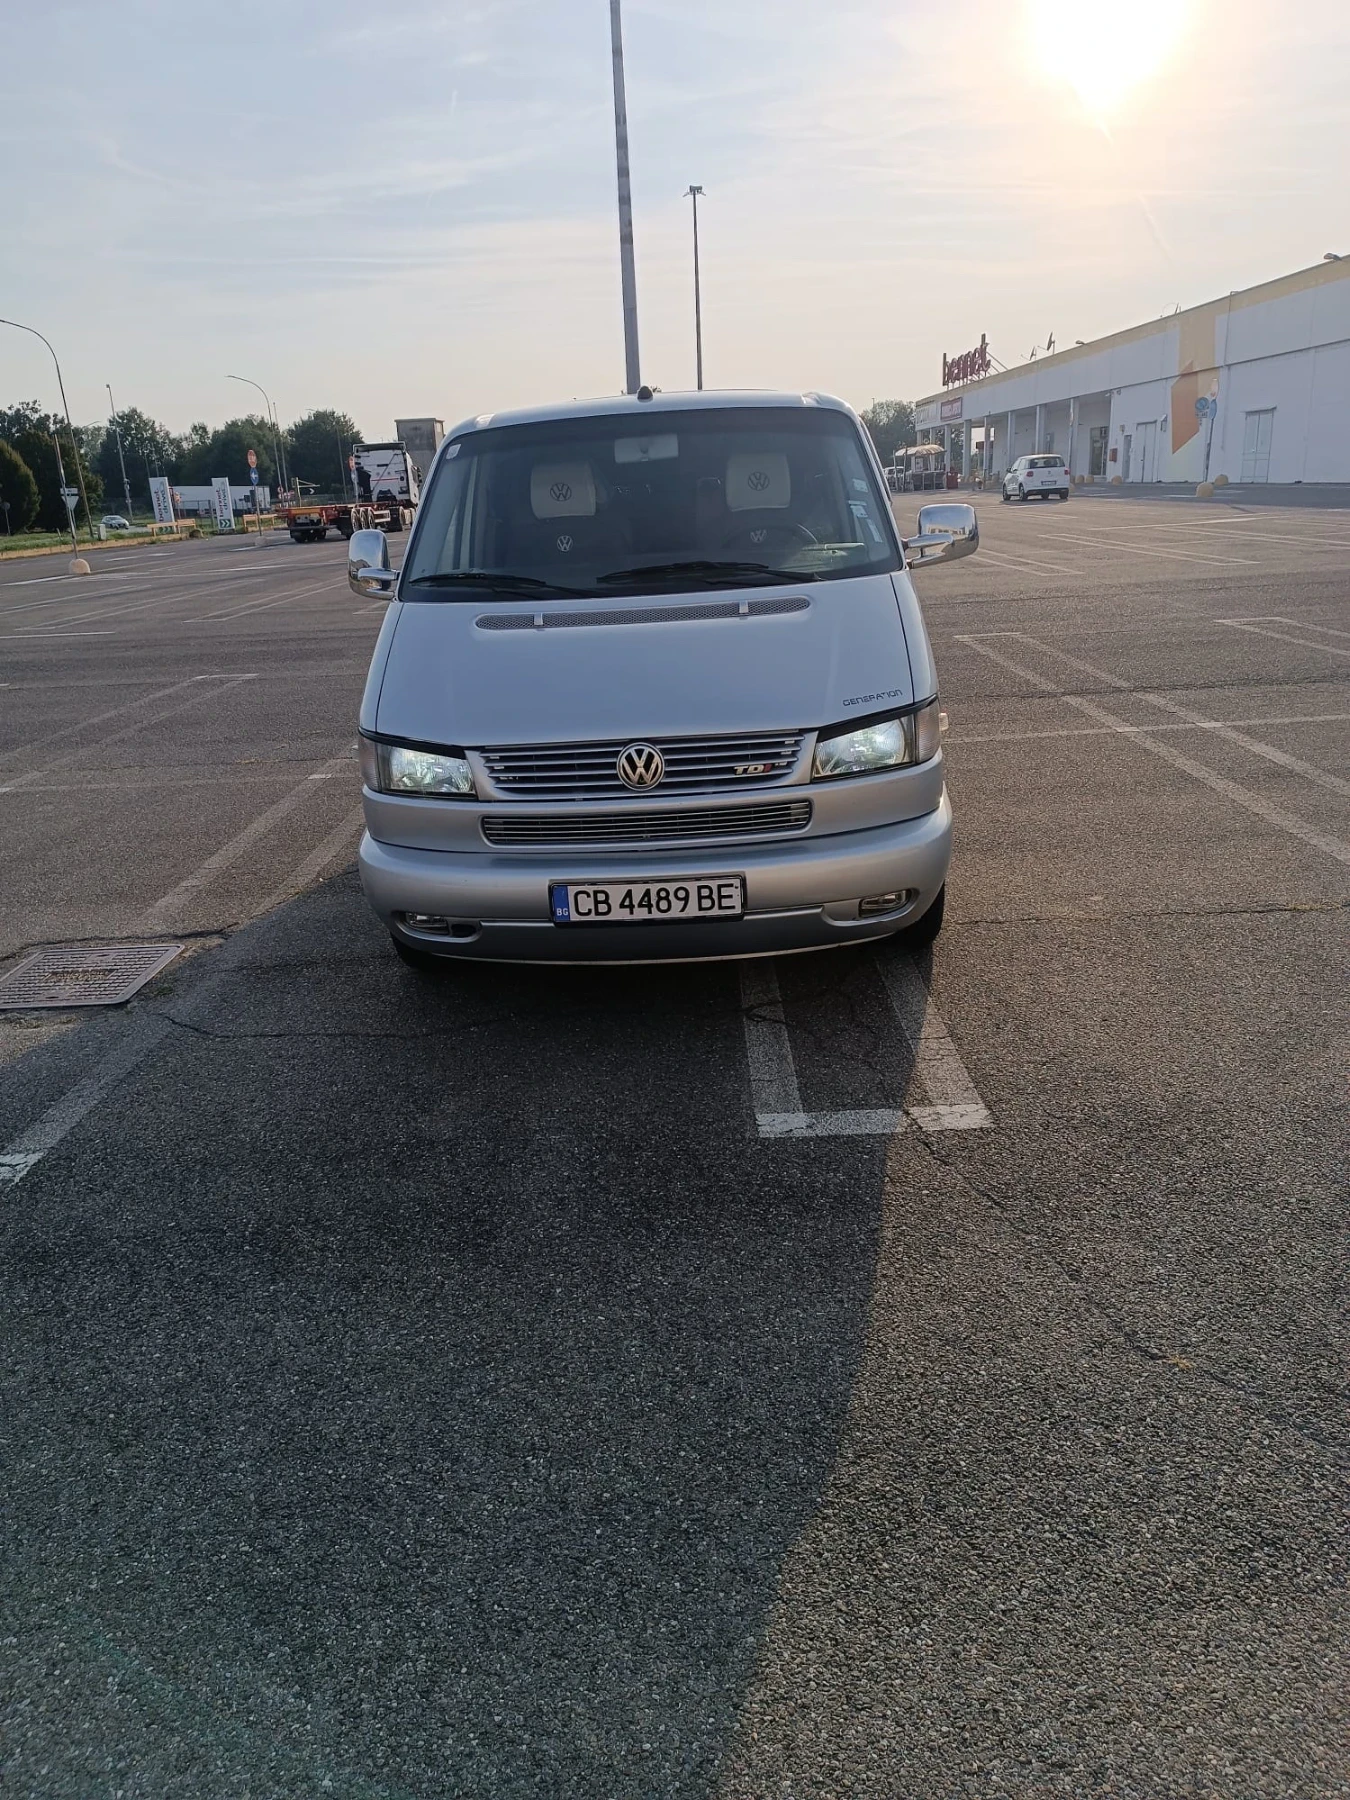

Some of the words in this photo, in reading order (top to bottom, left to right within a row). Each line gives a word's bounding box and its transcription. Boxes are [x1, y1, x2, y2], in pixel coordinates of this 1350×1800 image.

[942, 333, 991, 386] bennet
[842, 689, 903, 707] GENERATION
[616, 742, 665, 791] VW
[556, 907, 569, 916] BG
[573, 889, 612, 917] CB
[619, 886, 690, 915] 4489
[696, 883, 736, 912] BE
